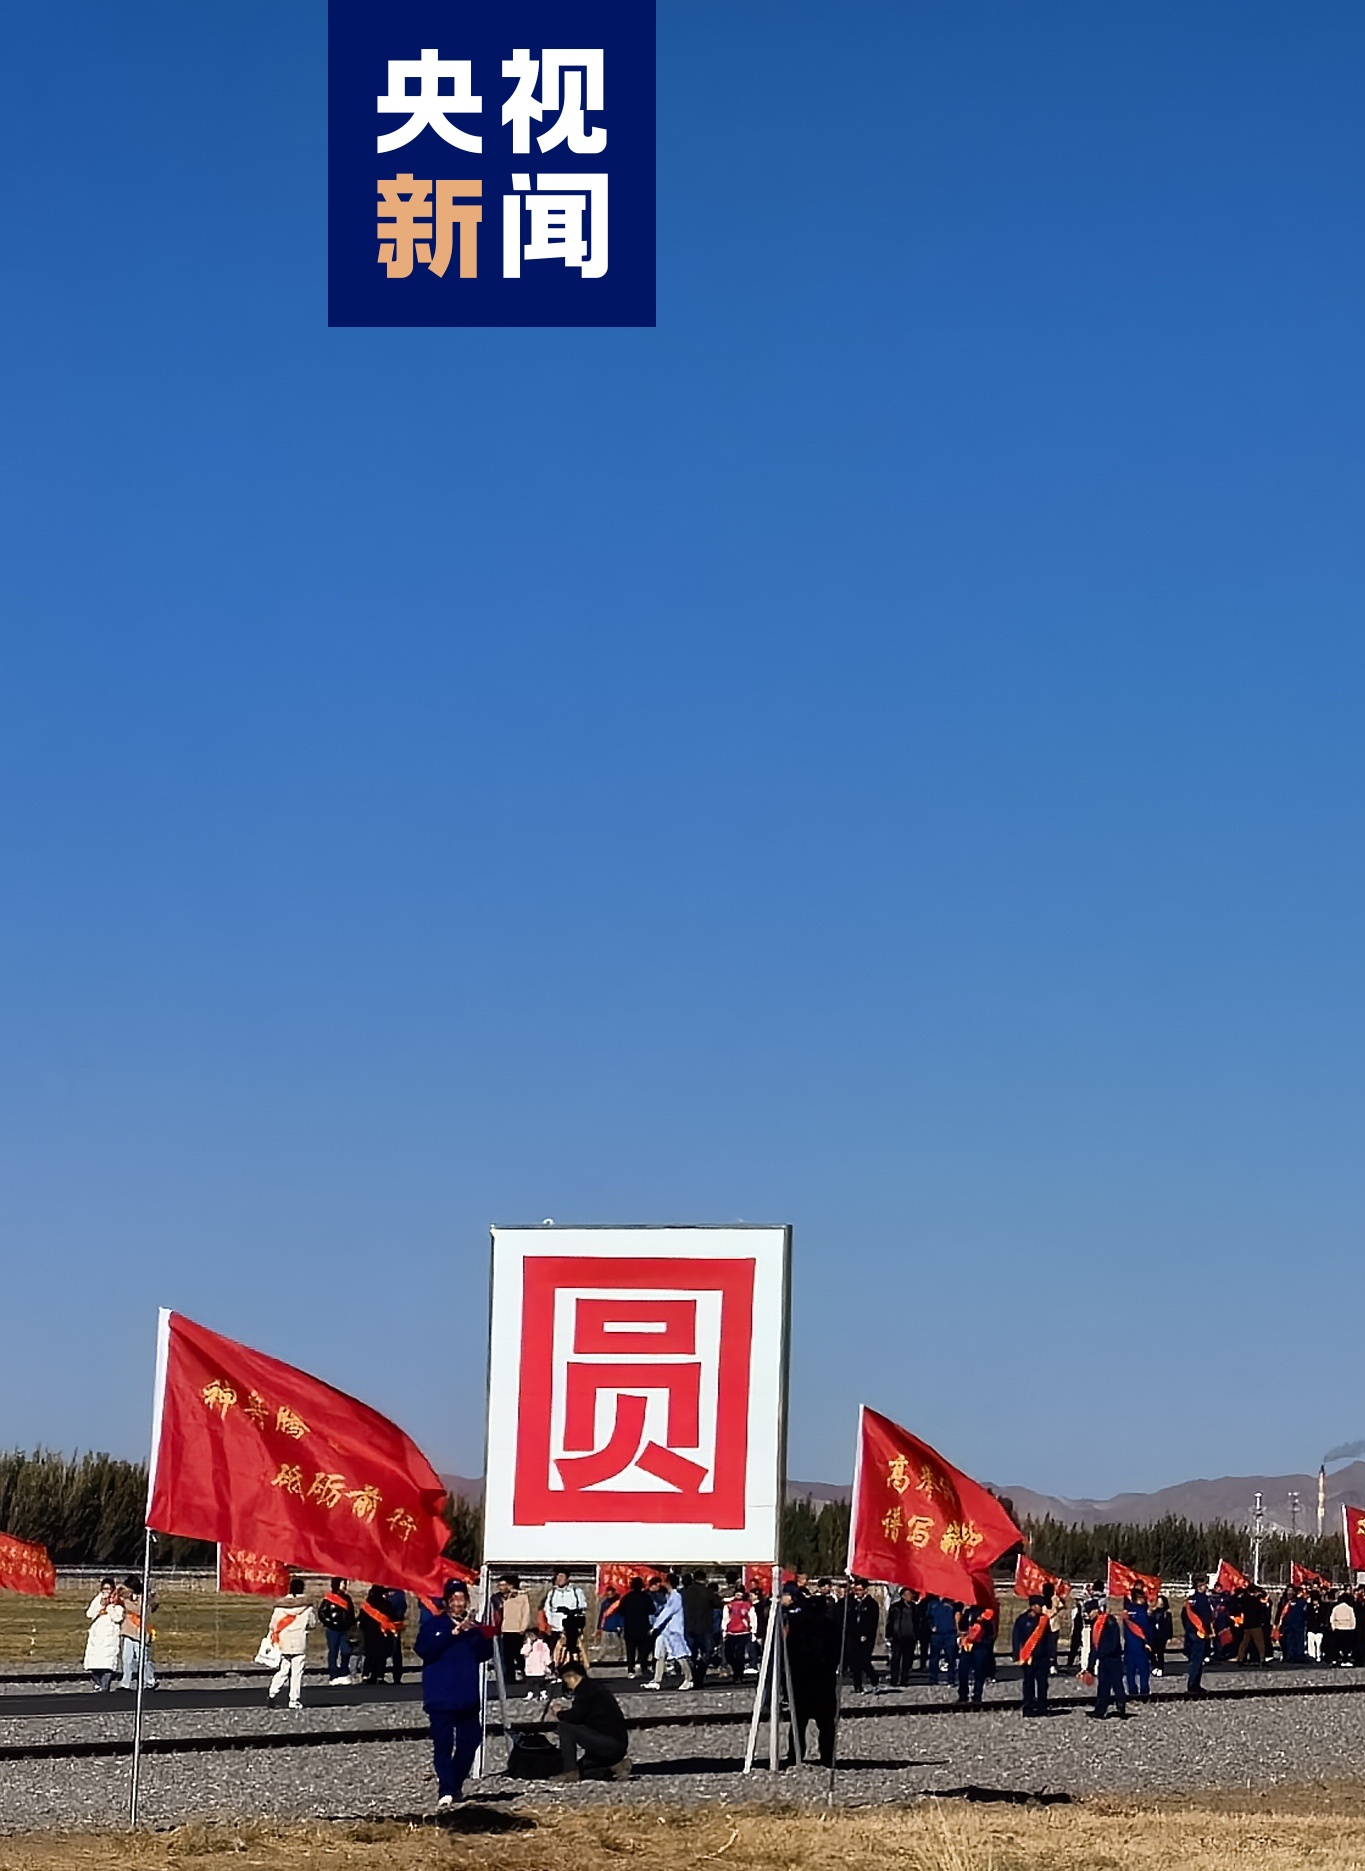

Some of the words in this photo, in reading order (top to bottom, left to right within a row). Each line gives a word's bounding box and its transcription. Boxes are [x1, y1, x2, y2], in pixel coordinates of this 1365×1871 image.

[513, 1256, 755, 1530] 圆
[271, 1463, 418, 1542] 砥砺前行
